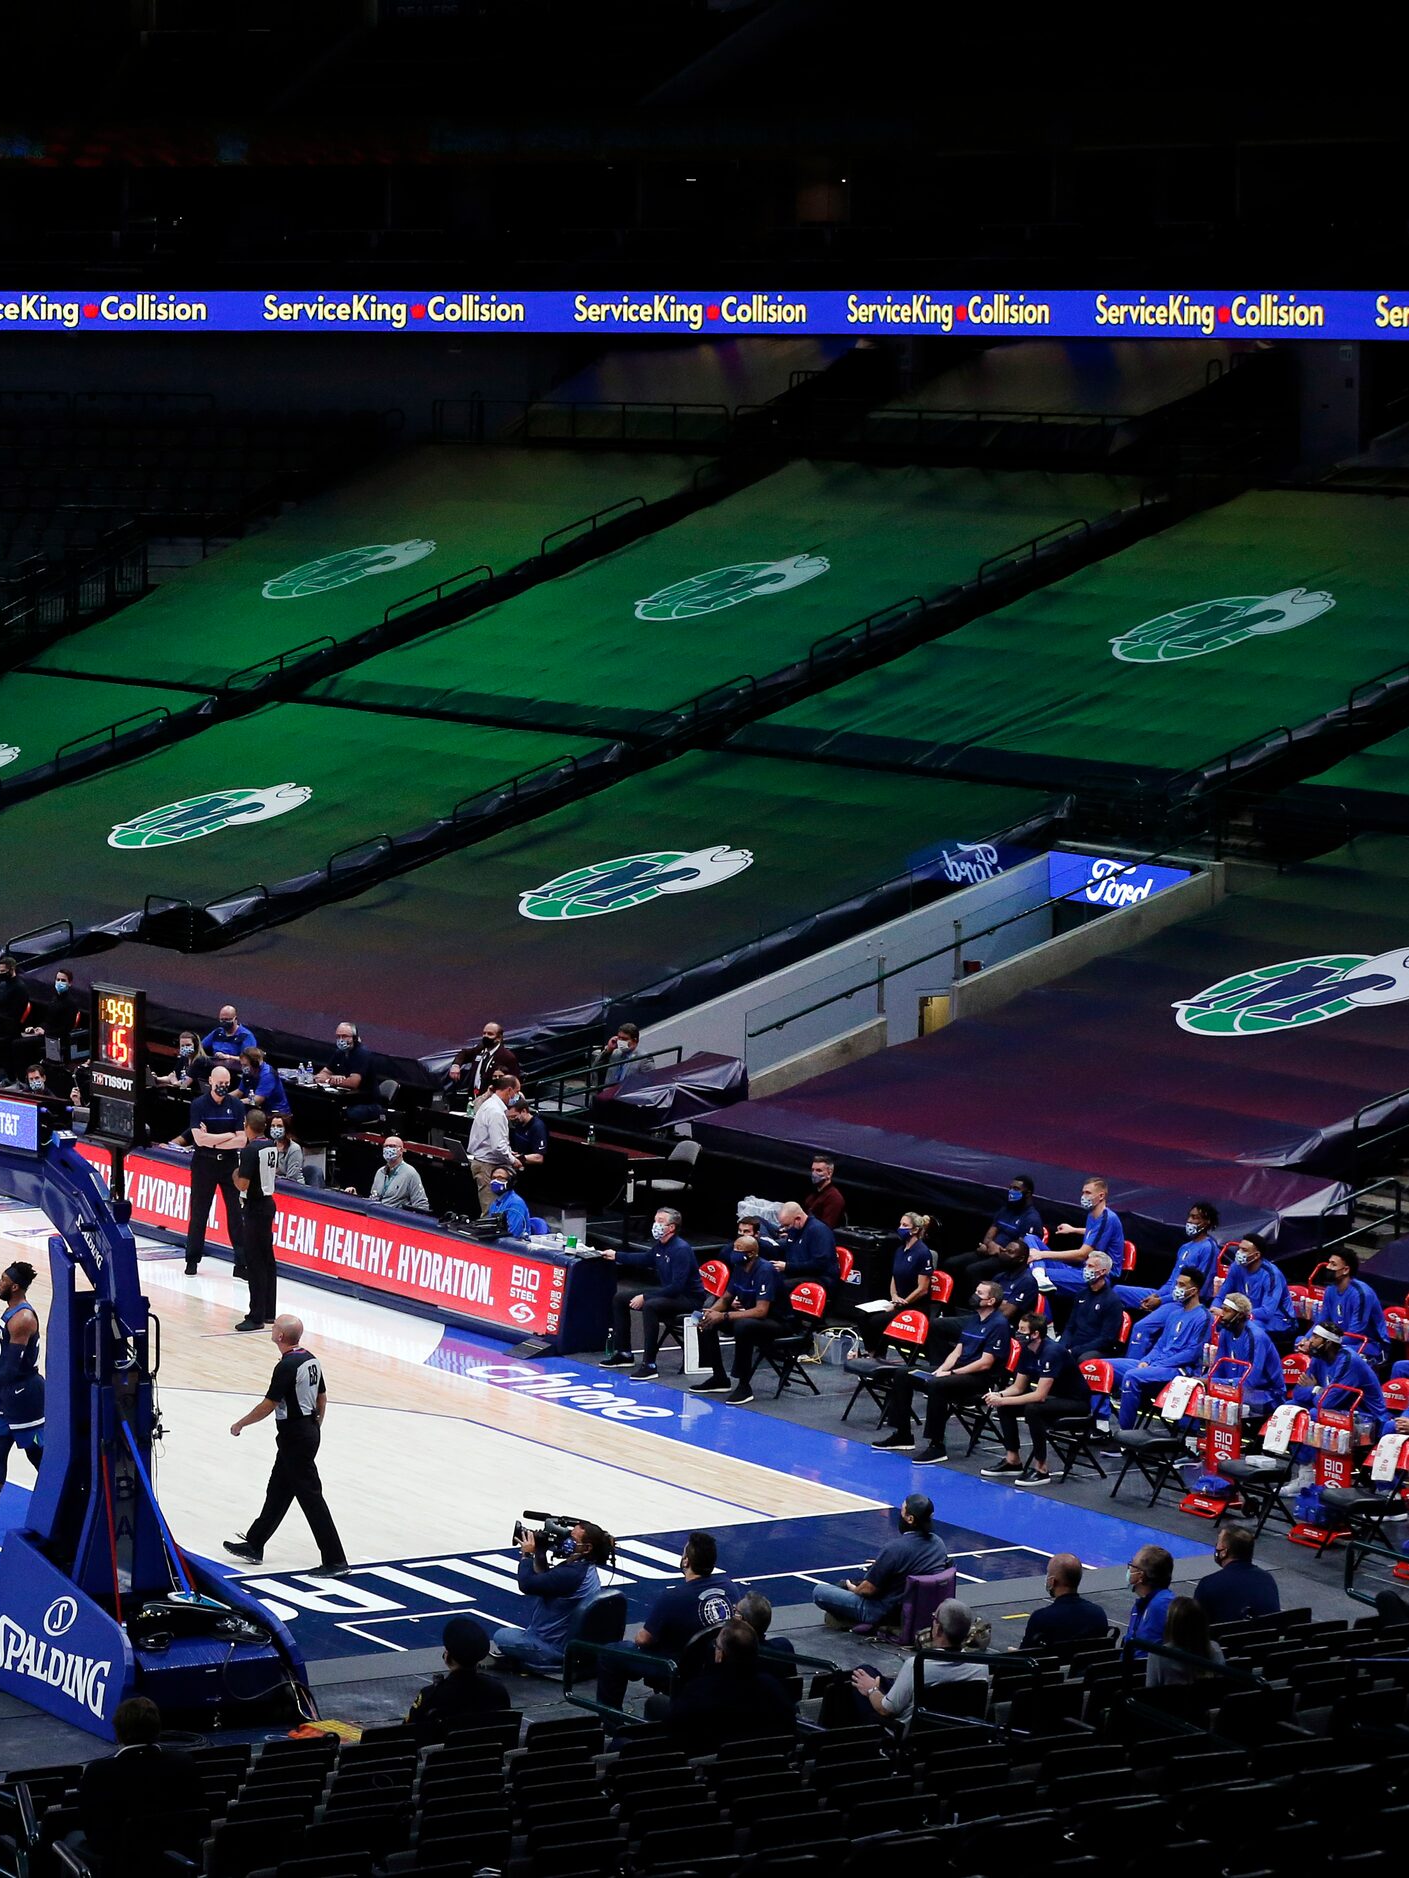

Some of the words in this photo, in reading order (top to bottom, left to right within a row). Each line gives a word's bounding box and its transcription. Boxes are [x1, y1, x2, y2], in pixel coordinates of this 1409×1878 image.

[101, 295, 206, 320] Collision
[264, 295, 406, 328] ServiceKing
[428, 295, 523, 321] Collision
[575, 295, 702, 329] ServiceKing
[722, 295, 806, 322] Collision
[847, 295, 952, 331] ServiceKing
[968, 294, 1049, 323] Collision
[1096, 295, 1214, 334] ServiceKing
[1232, 294, 1323, 325] Collision
[1086, 858, 1153, 906] Ford
[103, 1074, 134, 1092] TISSOT
[321, 1223, 393, 1278] HEALTHY.
[396, 1243, 495, 1306] HYDRATION.
[510, 1264, 540, 1291] BIO
[509, 1287, 538, 1303] STEEL
[464, 1364, 675, 1421] chime
[1214, 1429, 1233, 1445] BIO
[1324, 1458, 1343, 1474] BIO
